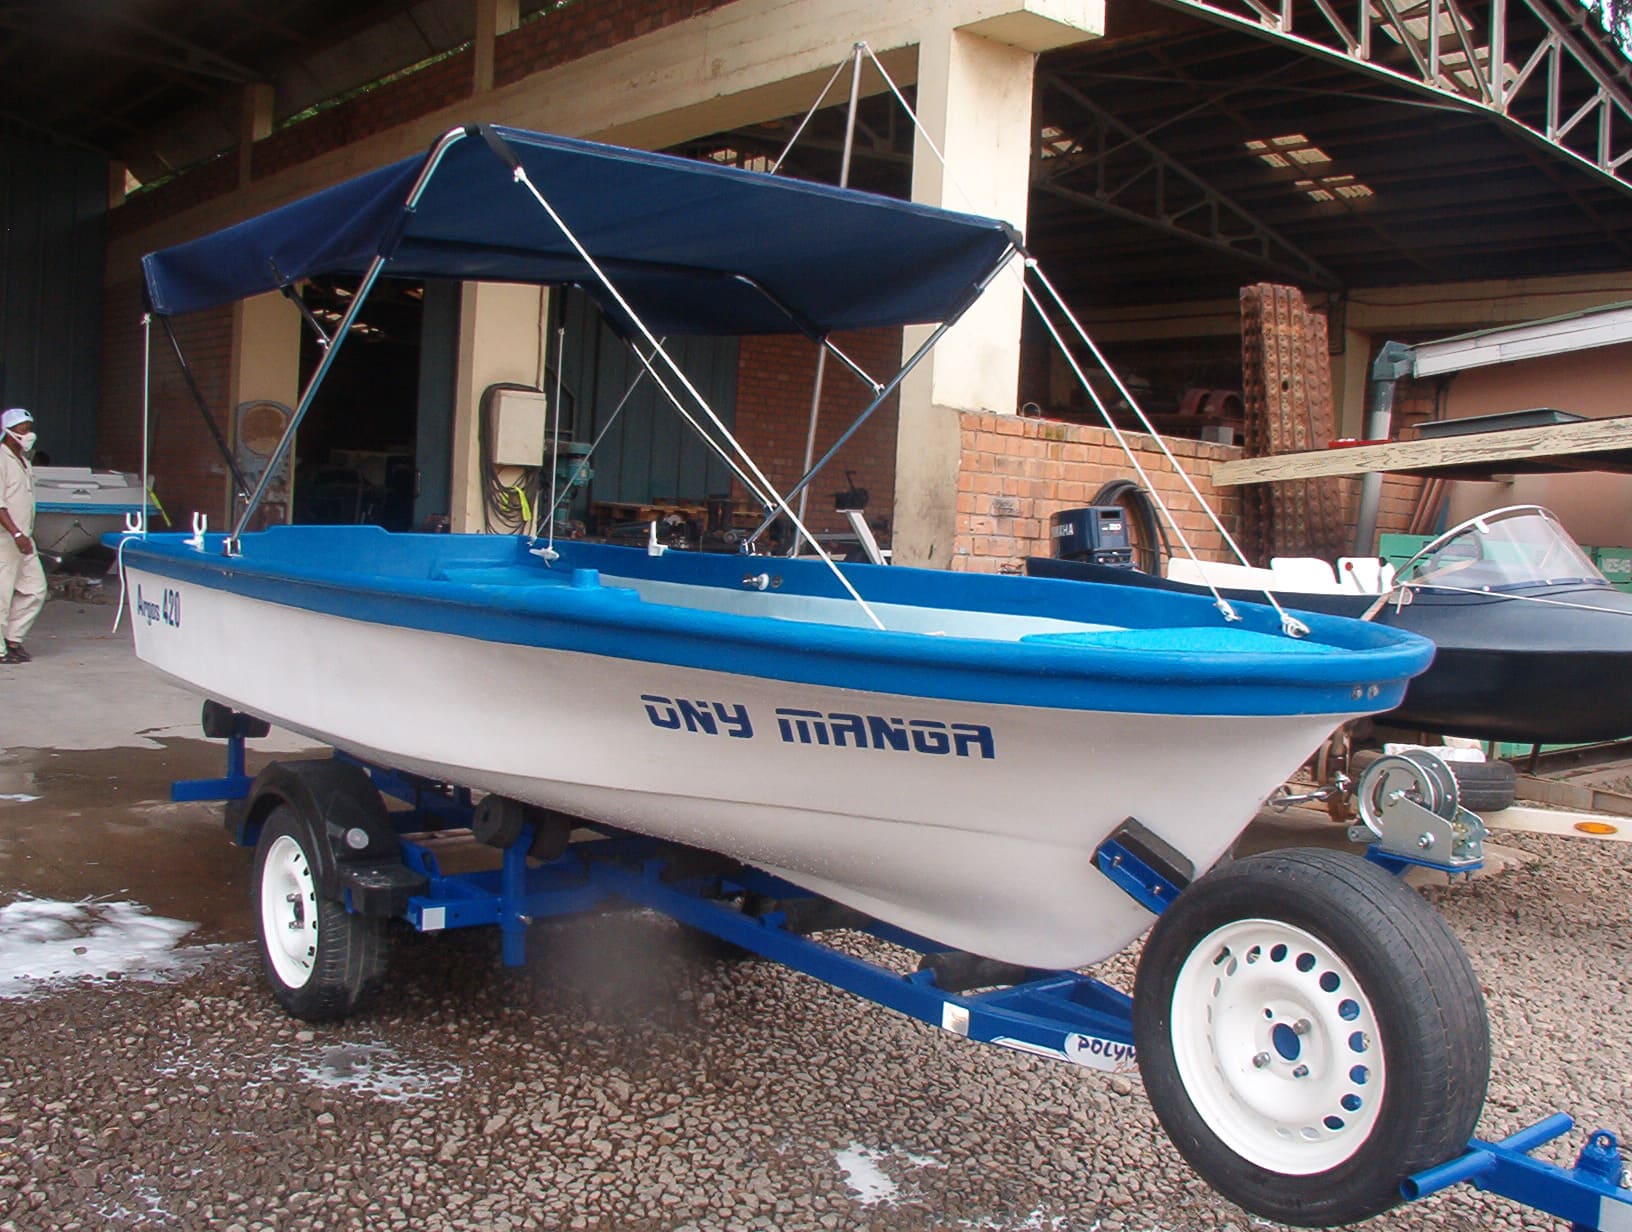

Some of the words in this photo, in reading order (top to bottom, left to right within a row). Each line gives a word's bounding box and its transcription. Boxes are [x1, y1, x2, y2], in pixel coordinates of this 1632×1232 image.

[163, 588, 181, 628] 420
[775, 708, 995, 760] MANGA
[1078, 1035, 1137, 1062] POLYM
